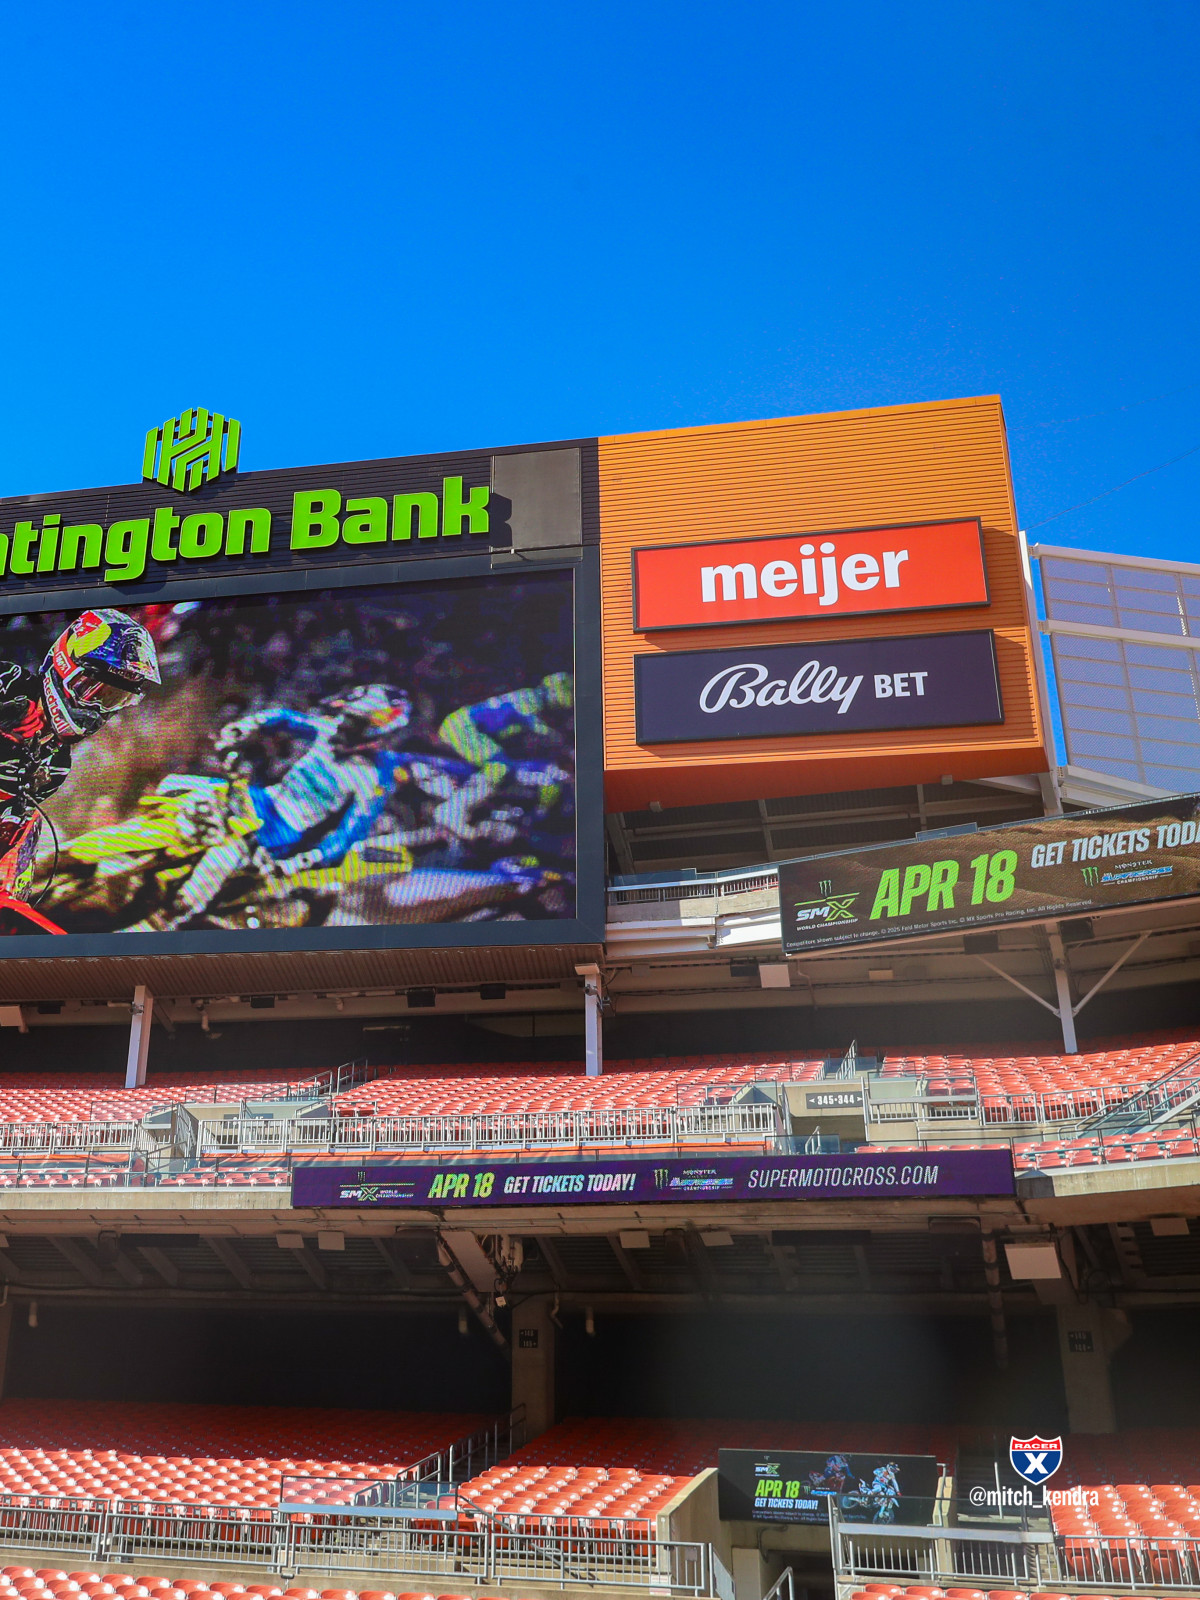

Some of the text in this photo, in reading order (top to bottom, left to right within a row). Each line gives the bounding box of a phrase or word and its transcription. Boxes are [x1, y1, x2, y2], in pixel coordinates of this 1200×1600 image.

[290, 475, 491, 550] Bank
[701, 542, 909, 606] meijer
[699, 660, 928, 714] Bally BET
[1030, 820, 1200, 868] GET TICKETS TOD
[869, 850, 1018, 920] APR 18
[1117, 875, 1158, 885] CHAMPIONSHIP
[796, 898, 856, 922] SMX
[817, 918, 858, 928] CHAMPIONSHIP
[428, 1172, 636, 1198] APR 18 GET TICKETS TODAY!
[748, 1164, 939, 1189] SUPERMOTOCROSS.COM
[340, 1187, 378, 1201] SMX
[755, 1480, 783, 1497] APR
[785, 1480, 801, 1498] 18
[754, 1498, 819, 1510] GET TICKETS TODAY!
